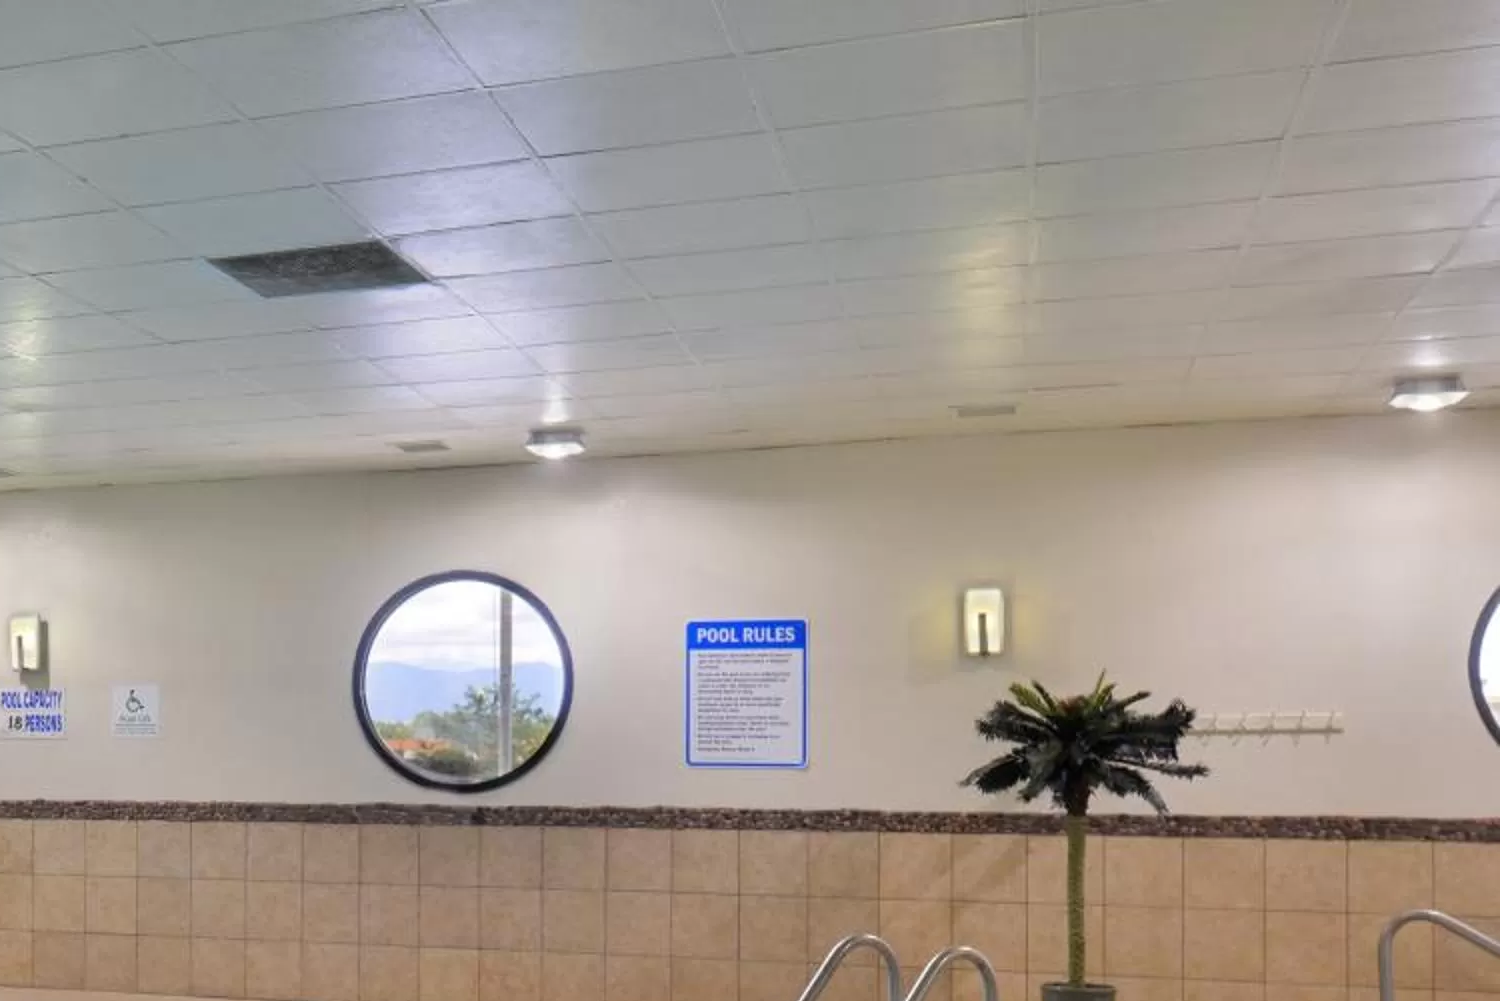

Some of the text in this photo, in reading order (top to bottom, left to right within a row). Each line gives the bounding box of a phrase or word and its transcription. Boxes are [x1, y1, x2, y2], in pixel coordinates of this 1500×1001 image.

[697, 627, 795, 643] POOL RULES
[25, 715, 62, 732] PERSONS
